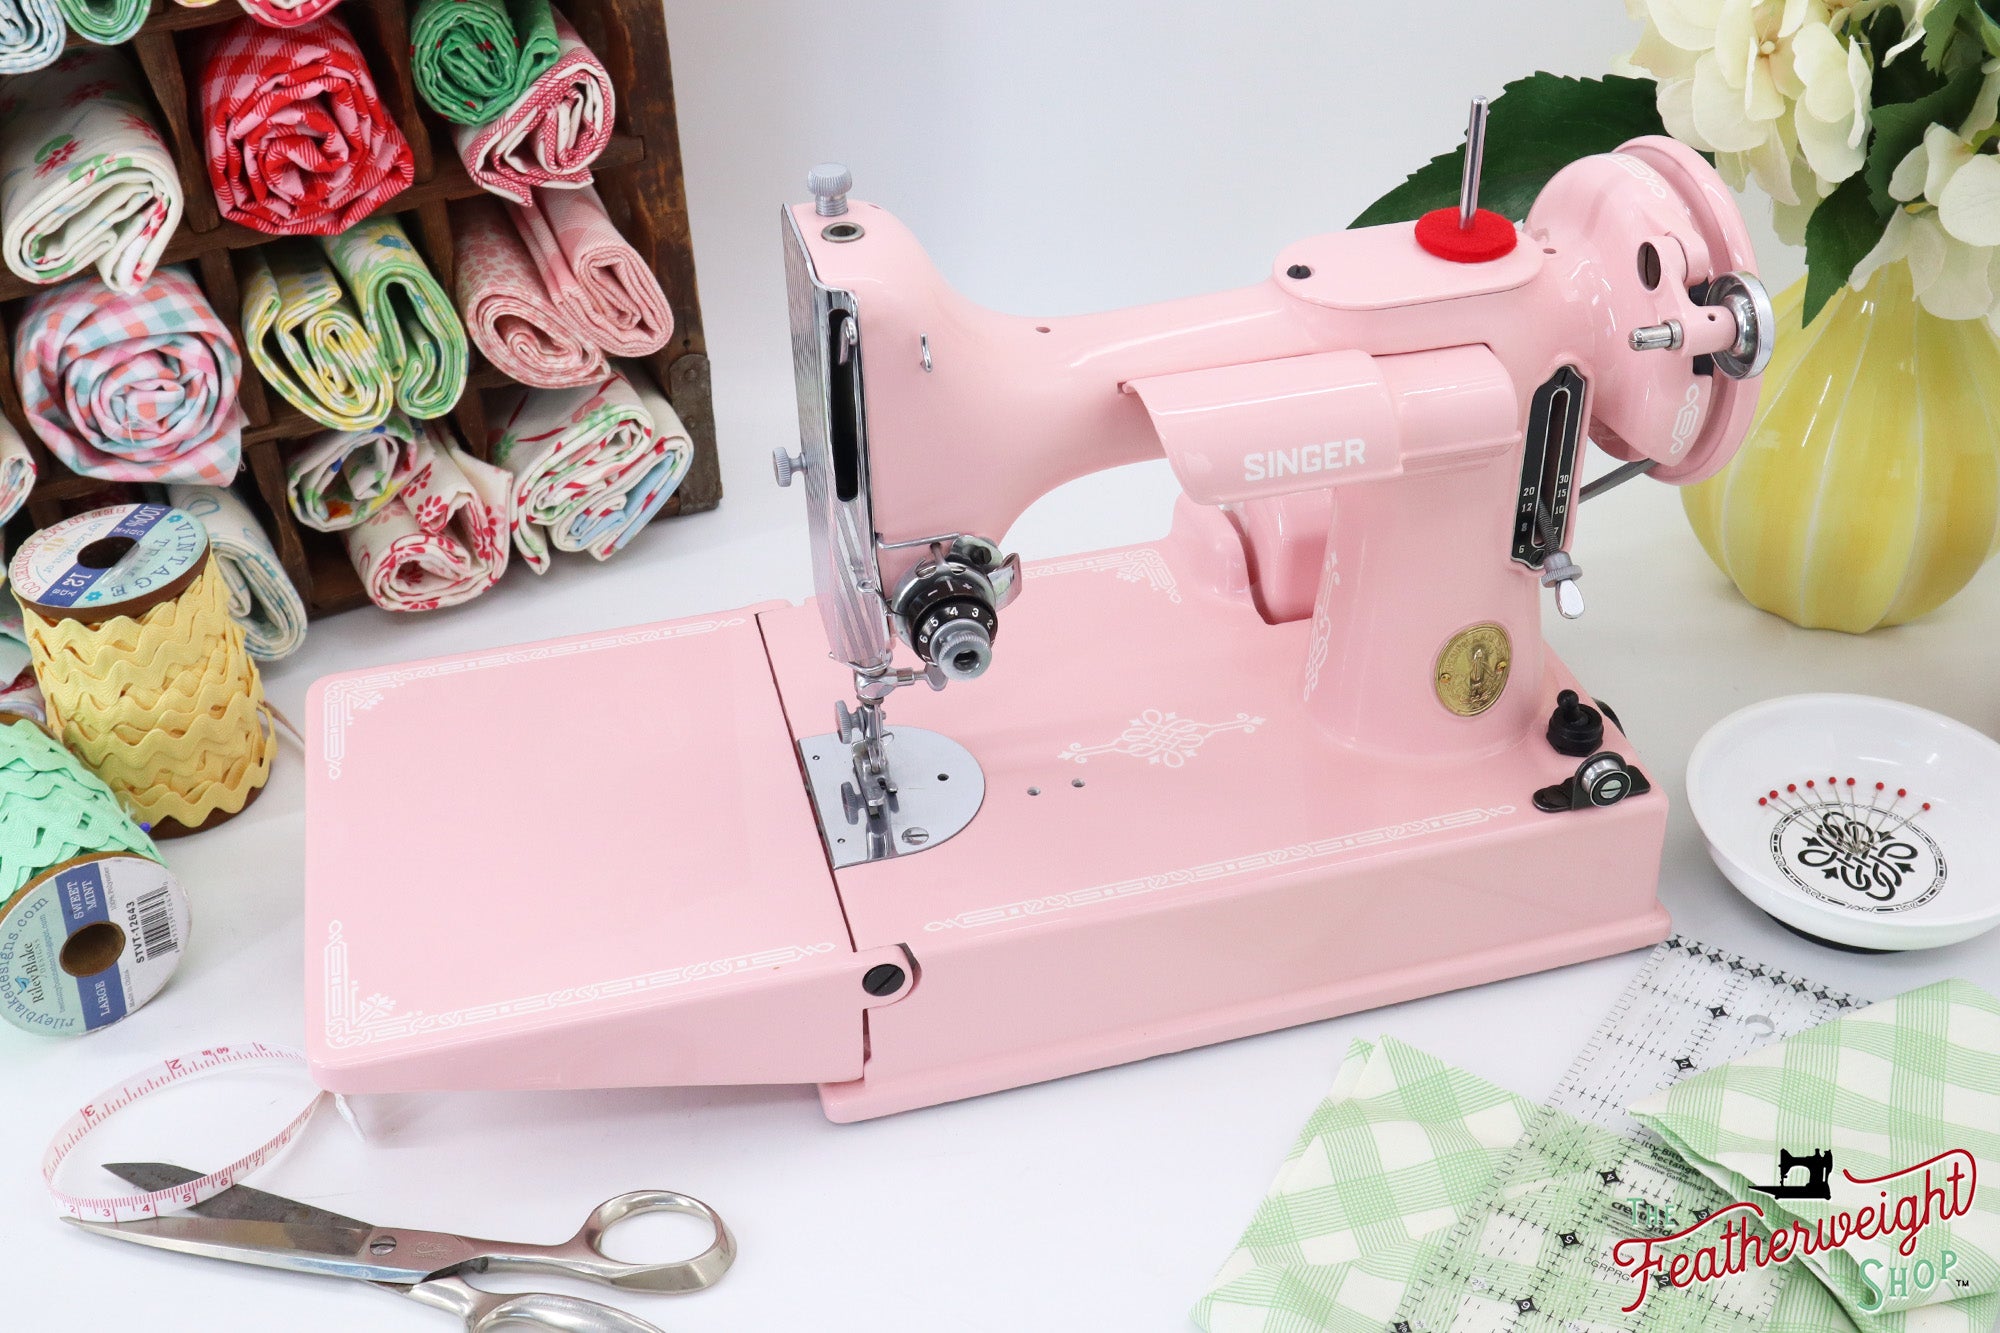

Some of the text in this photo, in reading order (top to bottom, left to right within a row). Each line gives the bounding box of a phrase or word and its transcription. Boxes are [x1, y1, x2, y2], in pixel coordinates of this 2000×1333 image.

[1243, 438, 1366, 481] SINGER
[1523, 475, 1569, 496] 20 30
[1522, 489, 1567, 512] 12 15
[1555, 506, 1564, 514] 10
[68, 515, 86, 526] IN
[125, 506, 165, 526] 100%
[40, 526, 65, 541] MY
[111, 522, 196, 597] VINTAGE
[1519, 545, 1525, 553] 6
[15, 543, 40, 582] BONNET
[62, 572, 92, 586] 12
[930, 617, 938, 626] 5
[950, 607, 993, 629] 4 3 2
[920, 635, 928, 643] 6
[66, 882, 84, 920] SWEET
[82, 881, 96, 911] MINT
[126, 902, 144, 964] STVT-12643
[95, 981, 110, 1016] LARGE
[169, 1058, 182, 1070] 2
[84, 1105, 96, 1117] 3
[1651, 1152, 1700, 1176] Rectangle
[1634, 1160, 1705, 1191] Primitive Gatherings
[103, 1209, 110, 1217] 3
[142, 1204, 150, 1212] 4
[183, 1193, 191, 1202] 5
[220, 1178, 228, 1186] 6
[1660, 1276, 1669, 1284] 2
